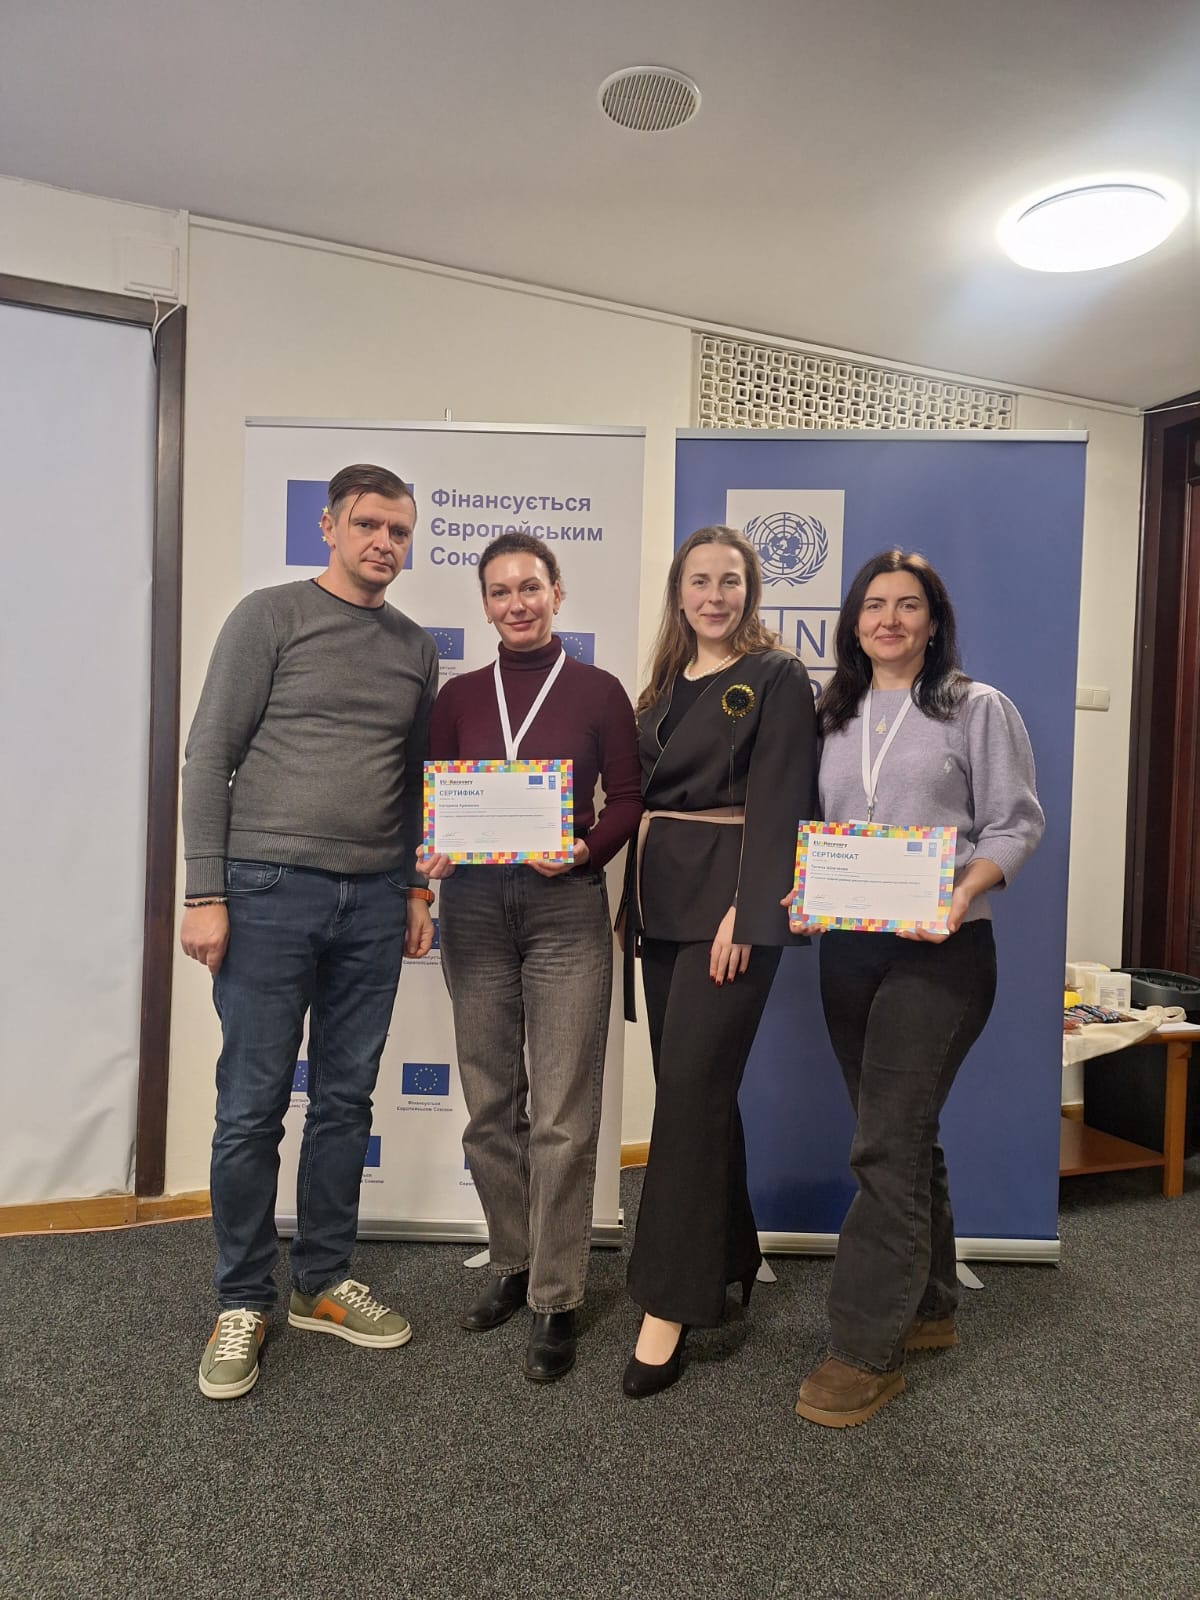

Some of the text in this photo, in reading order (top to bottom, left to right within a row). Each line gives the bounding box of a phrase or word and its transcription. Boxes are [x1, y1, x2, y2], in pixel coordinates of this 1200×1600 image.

[431, 488, 591, 514] Фінансується
[430, 517, 603, 541] Європейським
[430, 546, 480, 566] Сою
[439, 789, 484, 797] СЕРТИФІКАТ
[811, 851, 859, 861] СЕРТИФІКАТ
